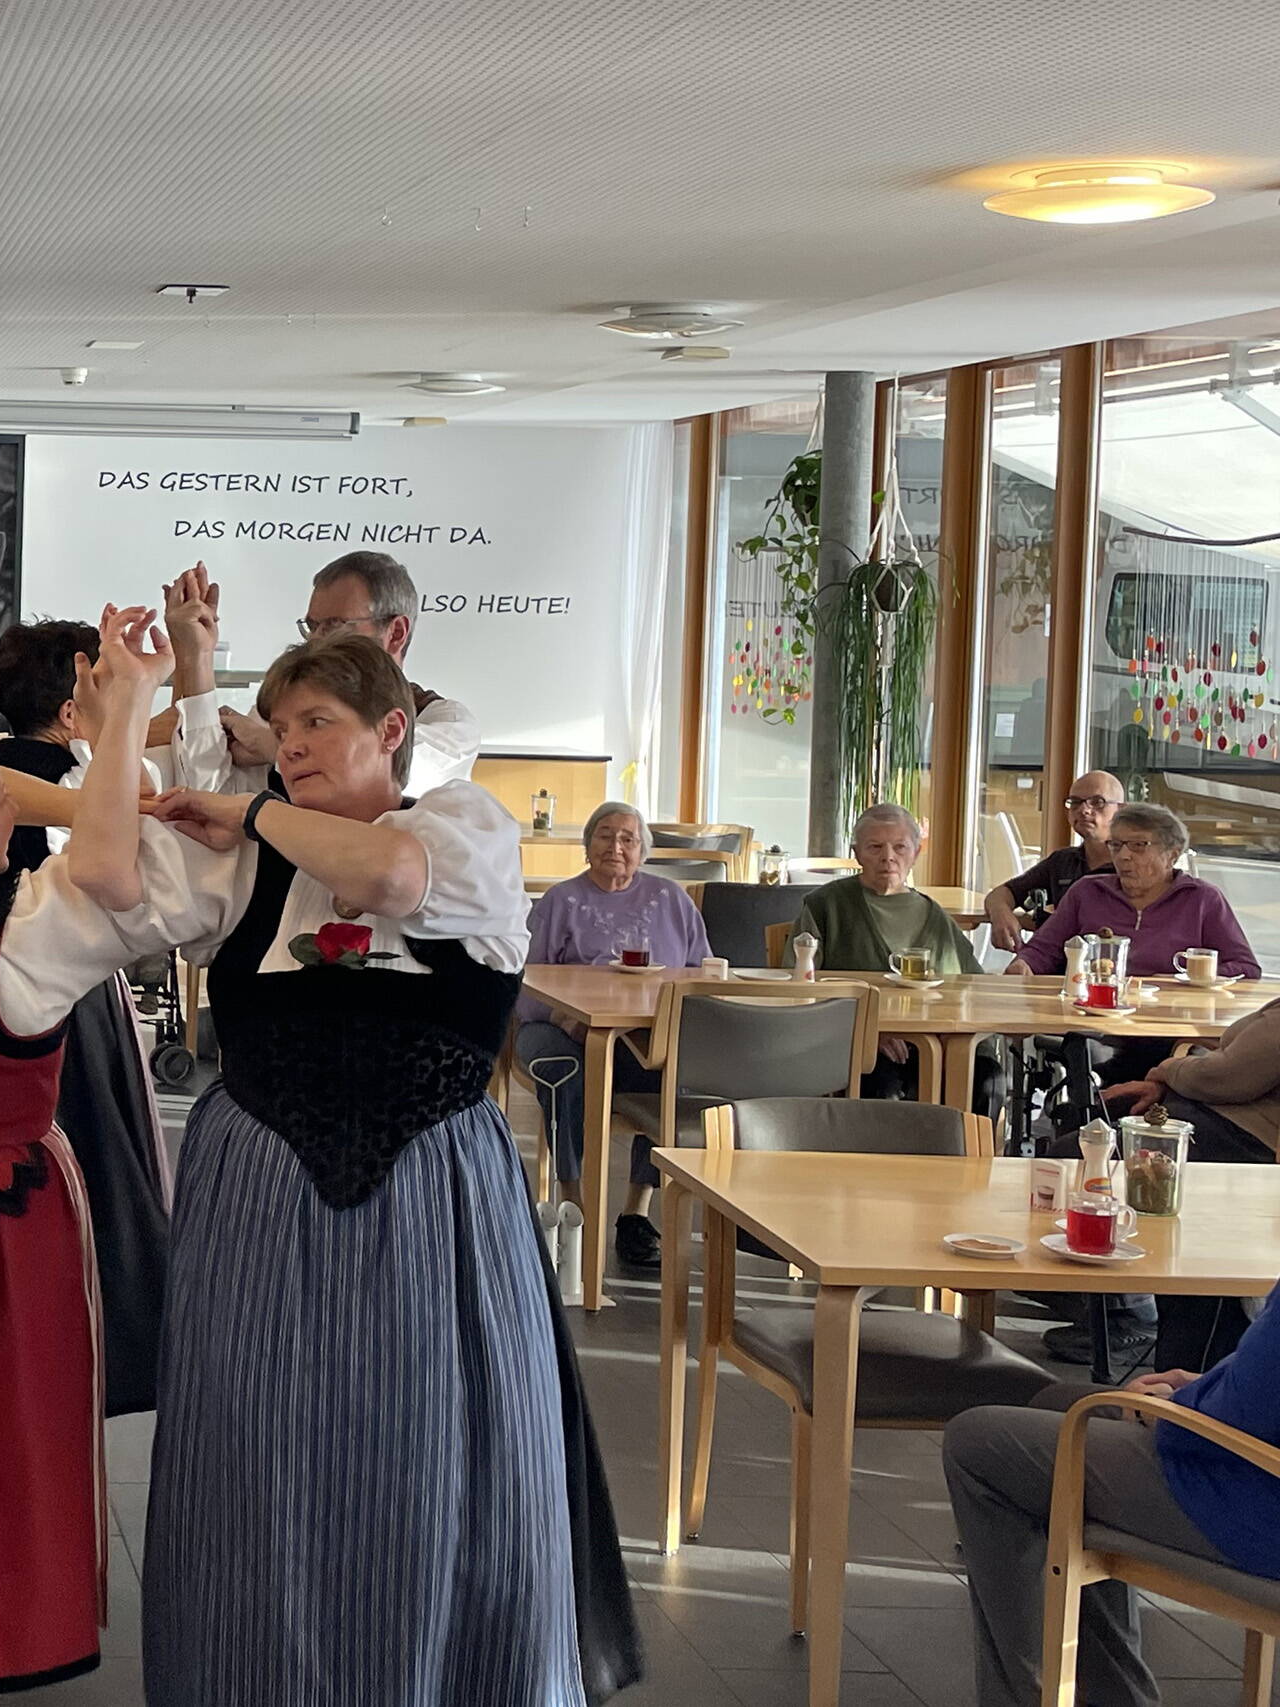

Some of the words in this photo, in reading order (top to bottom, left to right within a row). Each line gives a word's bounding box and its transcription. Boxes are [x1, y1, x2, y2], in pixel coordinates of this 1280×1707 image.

[98, 471, 150, 490] DAS
[159, 472, 281, 492] GESTERN
[291, 474, 330, 494] IST
[338, 476, 413, 497] FORT,
[174, 520, 225, 539] DAS
[235, 521, 351, 542] MORGEN
[361, 523, 440, 544] NICHT
[449, 527, 492, 545] DA.
[420, 594, 467, 613] LSO
[477, 594, 571, 615] HEUTE!
